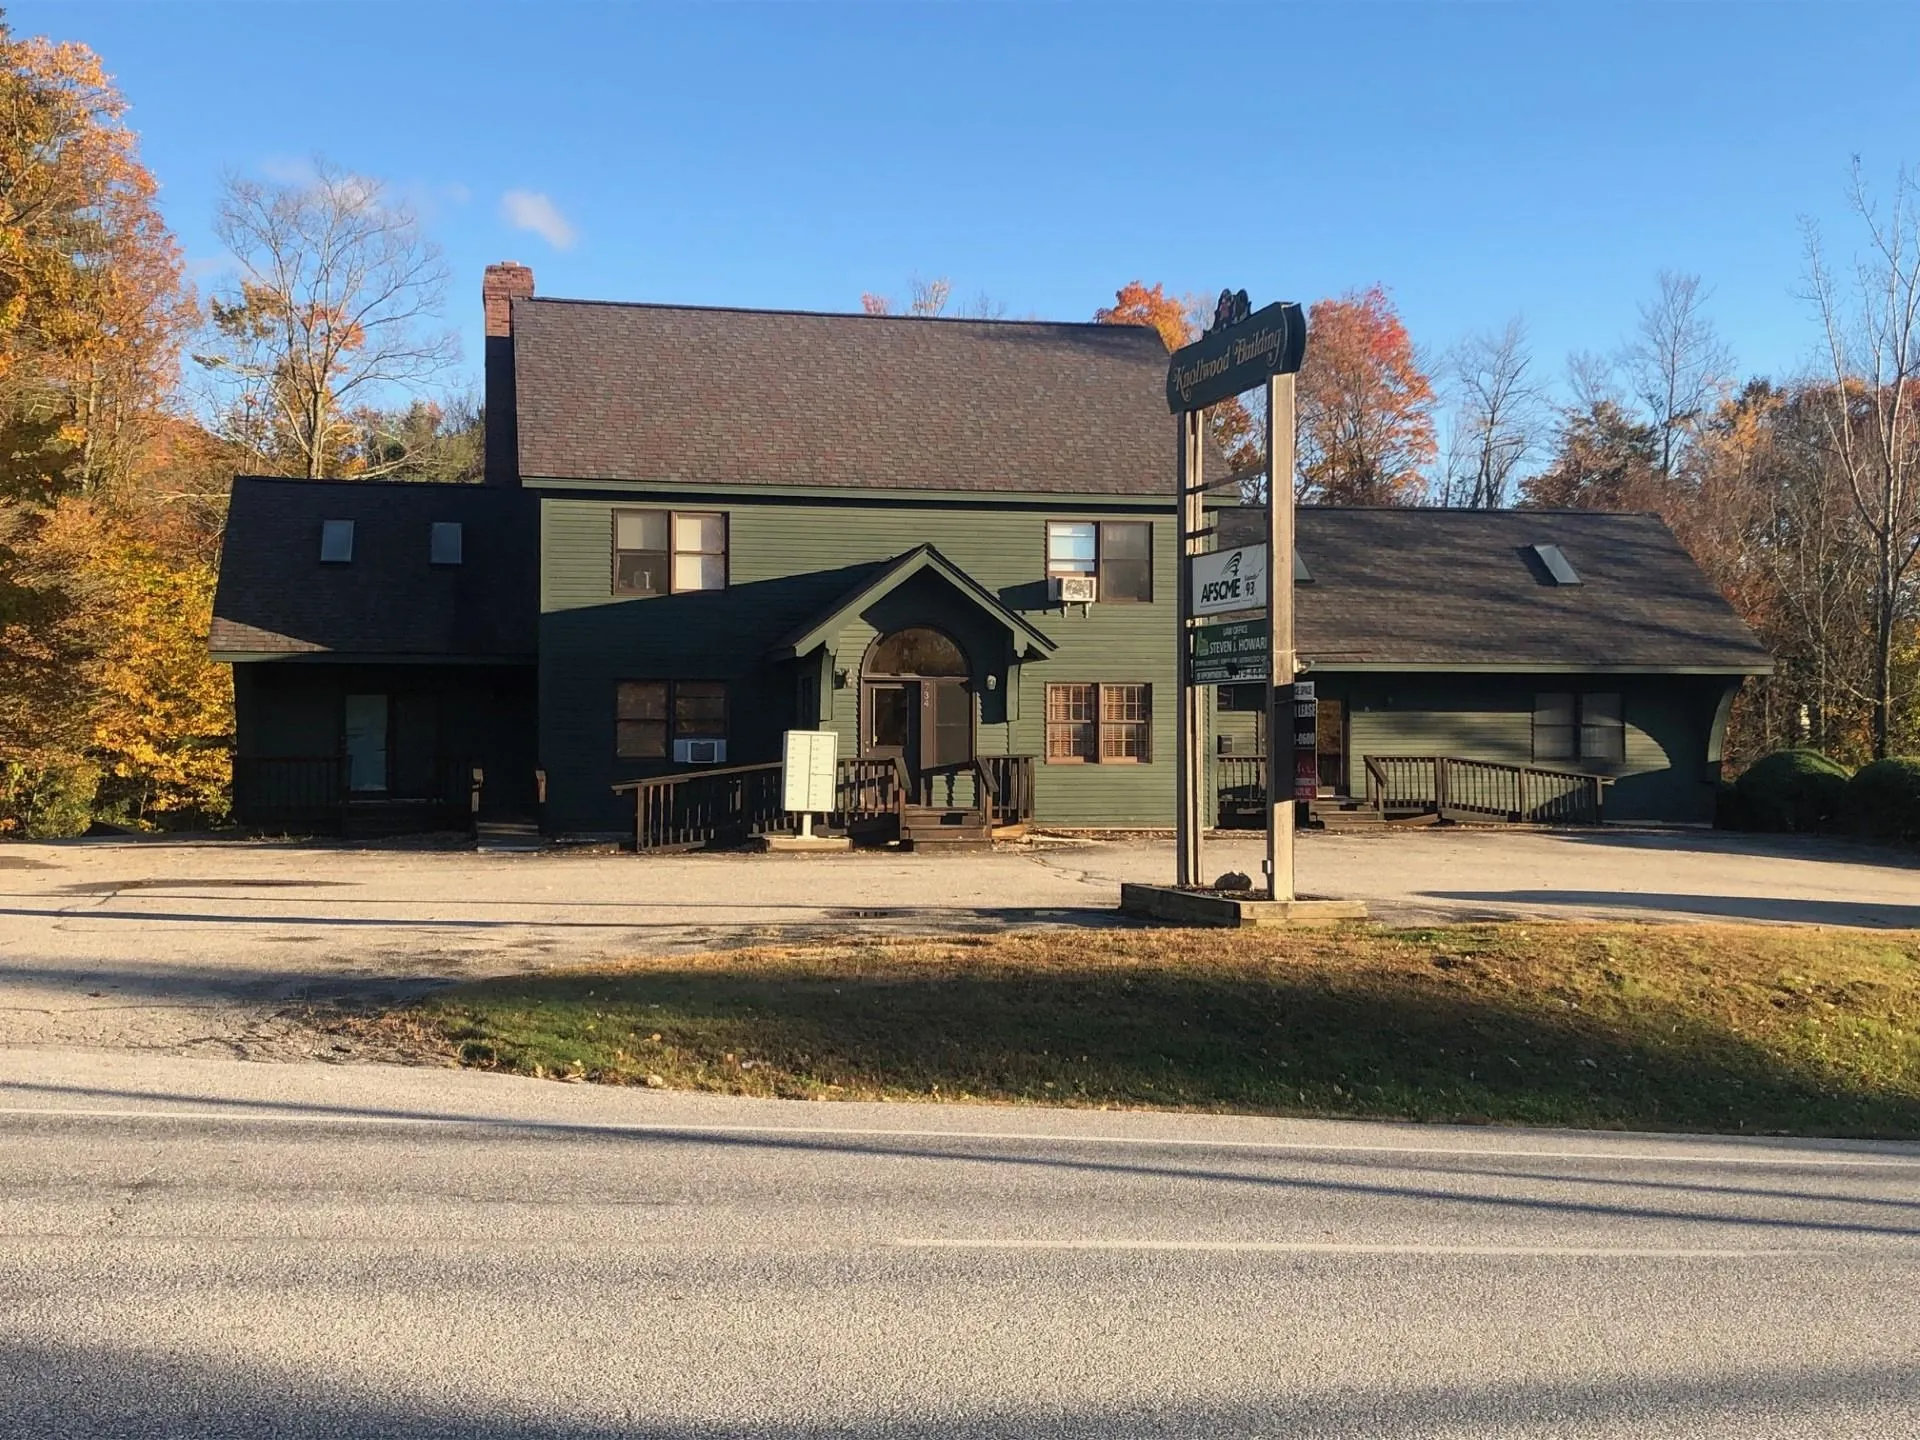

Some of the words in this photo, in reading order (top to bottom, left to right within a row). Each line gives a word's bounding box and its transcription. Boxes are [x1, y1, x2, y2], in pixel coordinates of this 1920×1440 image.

[1172, 345, 1231, 402] Knollwood
[1233, 327, 1282, 368] Building
[1201, 578, 1240, 603] AFSCME
[1246, 582, 1255, 596] 93
[1223, 628, 1232, 636] LAW
[1232, 625, 1248, 635] OFFICE
[1209, 641, 1231, 655] STEVEN
[1298, 704, 1315, 718] LEASE
